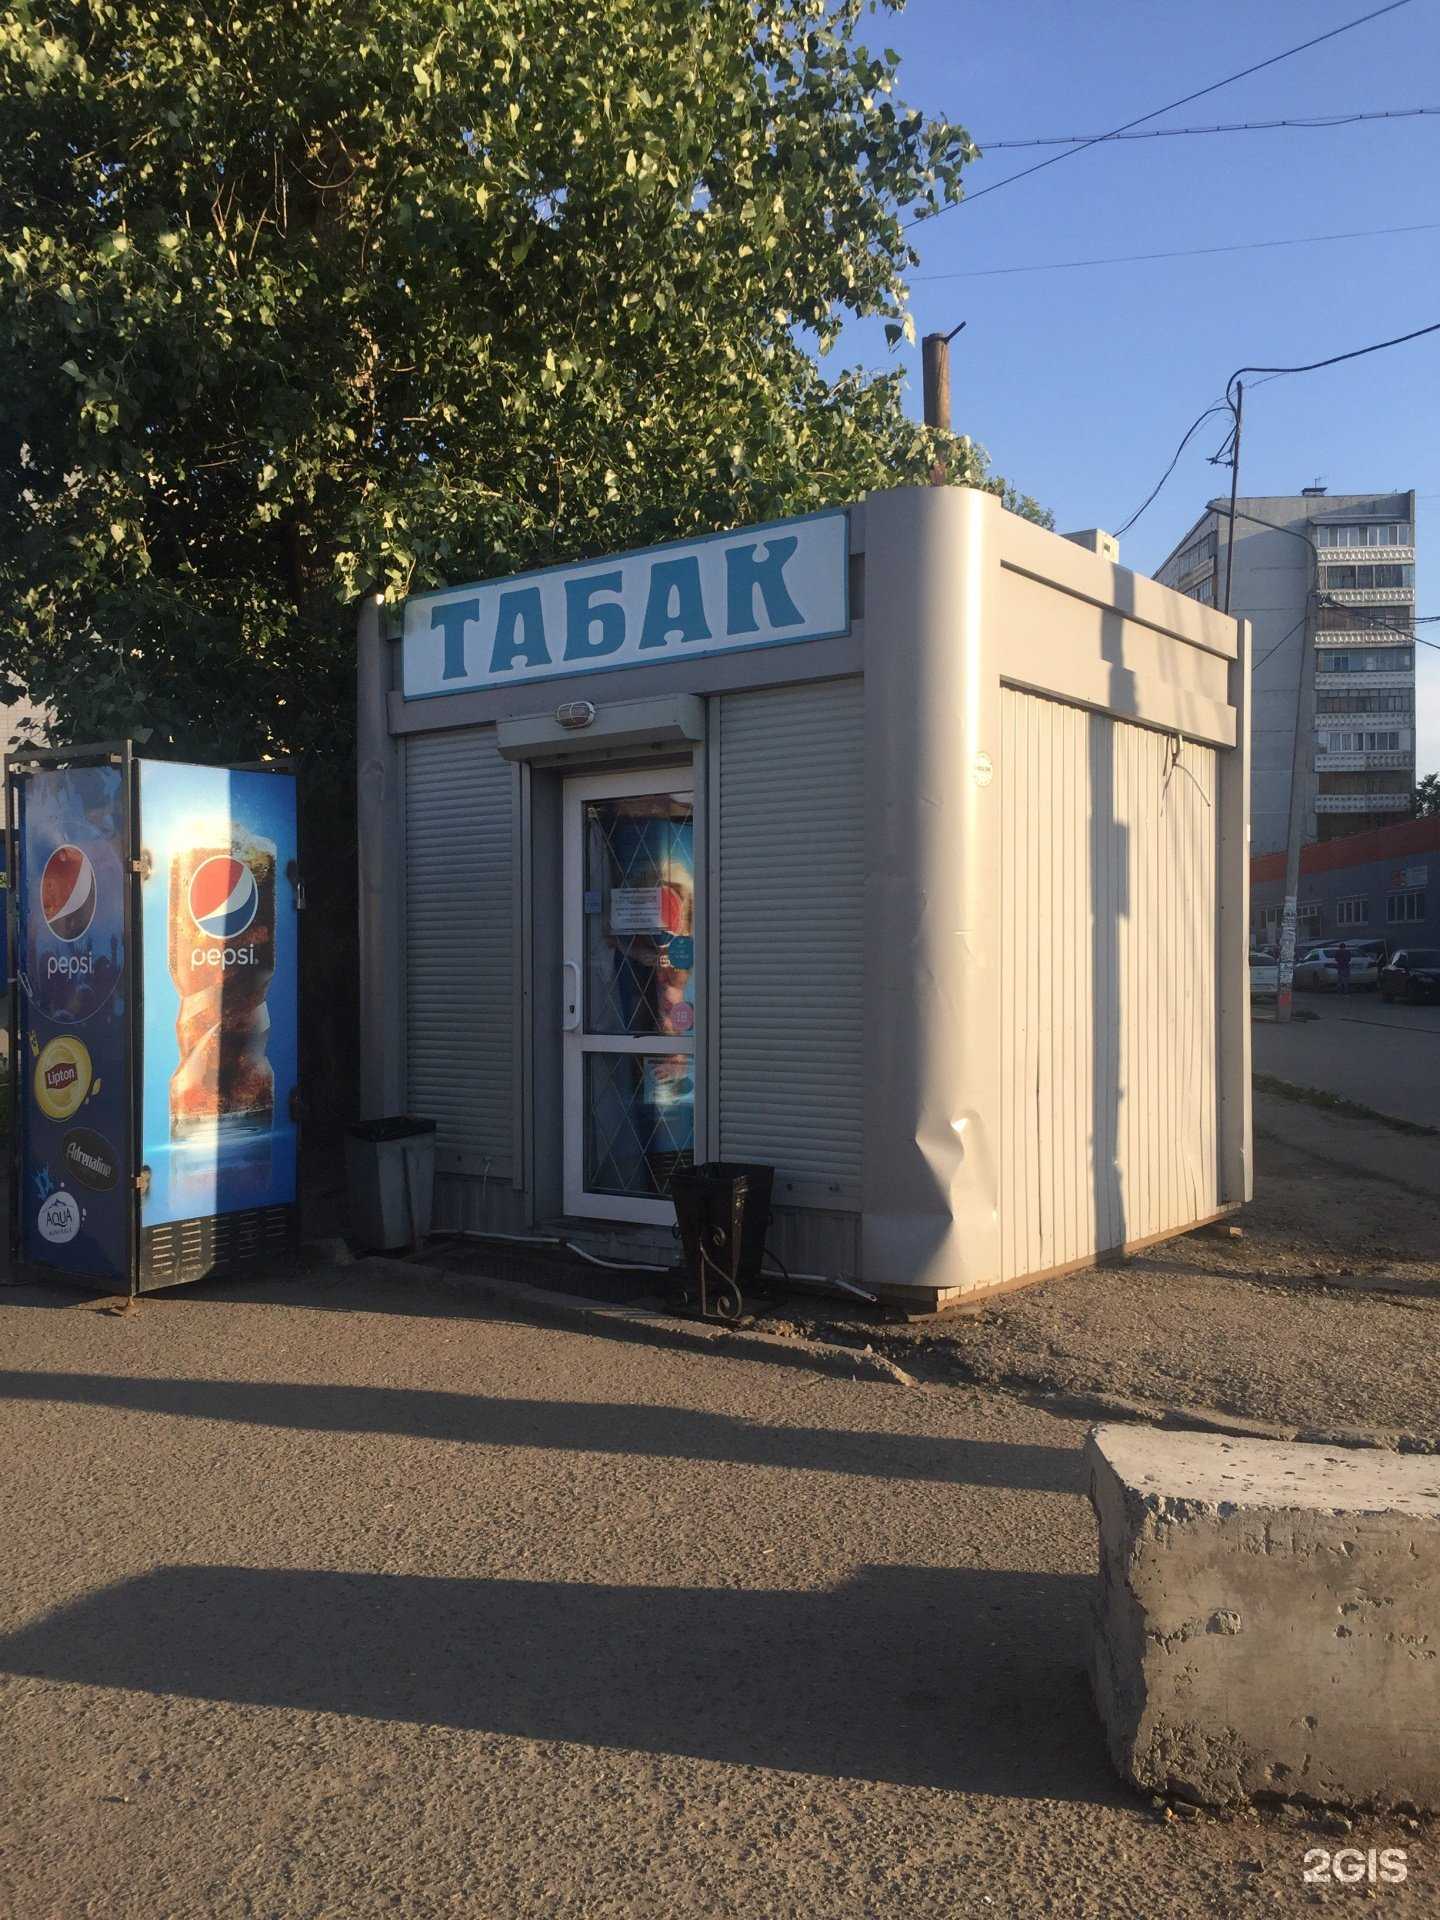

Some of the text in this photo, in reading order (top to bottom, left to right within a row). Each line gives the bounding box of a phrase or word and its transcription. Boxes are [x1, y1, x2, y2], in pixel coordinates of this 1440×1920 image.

[431, 535, 806, 681] ТАБАК
[47, 952, 94, 979] pepsi
[190, 944, 255, 970] pepsi
[47, 1068, 75, 1086] Lipton
[67, 1142, 111, 1178] Adrenaline
[46, 1207, 73, 1227] AQUA
